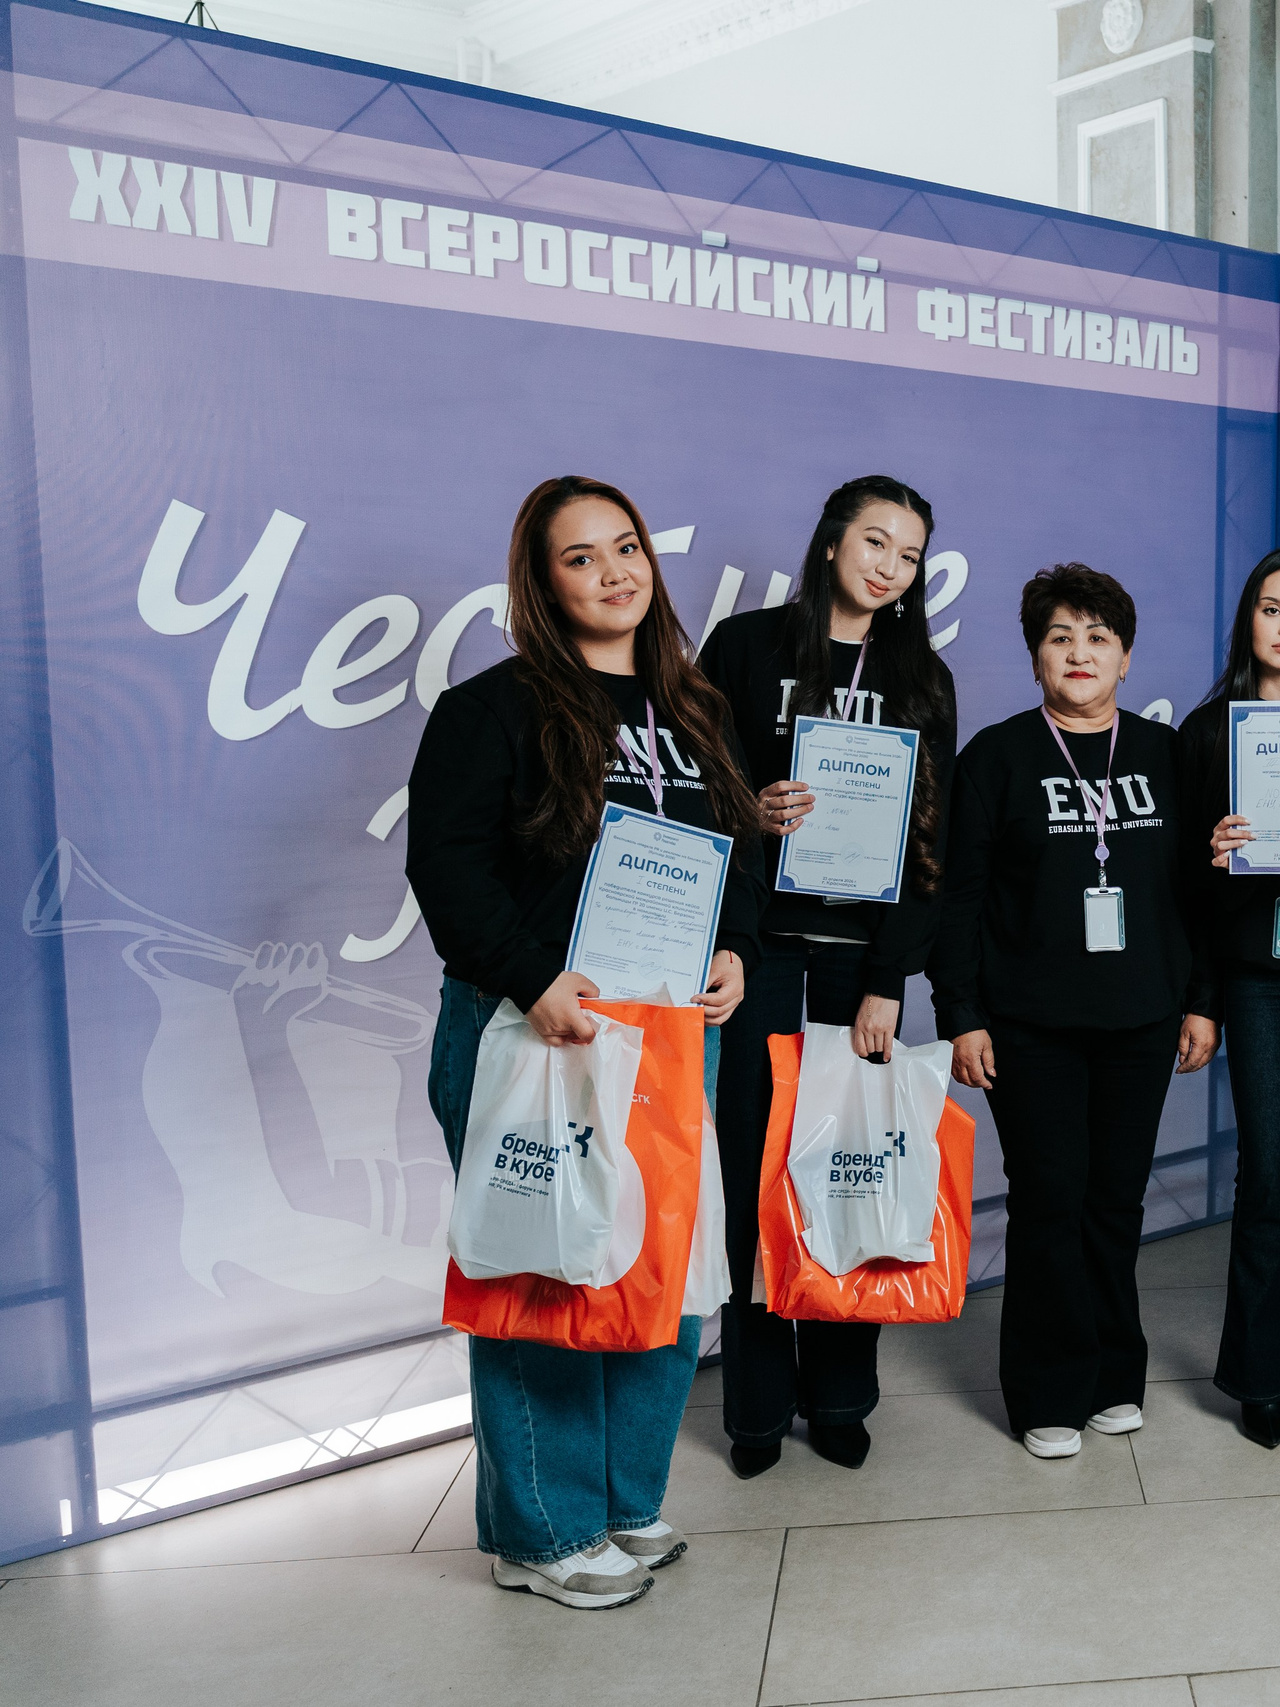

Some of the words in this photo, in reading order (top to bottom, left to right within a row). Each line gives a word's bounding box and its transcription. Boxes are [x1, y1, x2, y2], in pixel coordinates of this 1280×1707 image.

[68, 146, 275, 247] XXIV
[326, 188, 886, 333] ВСЕРОССИЙСКИЙ
[917, 288, 1199, 375] ФЕСТИВАЛЬ
[818, 759, 890, 777] ДИПЛОМ
[845, 779, 880, 789] СТЕПЕНИ
[1041, 774, 1156, 821] ENU
[1049, 825, 1083, 834] EURASIAN
[1123, 819, 1163, 829] UNIVERSITY
[619, 854, 698, 884] ДИПЛОМ
[646, 880, 686, 896] СТЕПЕНИ
[632, 1093, 650, 1104] СГК
[501, 1133, 560, 1164] бренд
[494, 1153, 507, 1169] в
[510, 1157, 555, 1182] кубе
[832, 1151, 884, 1168] бренд
[830, 1170, 841, 1182] в
[844, 1167, 883, 1186] кубе
